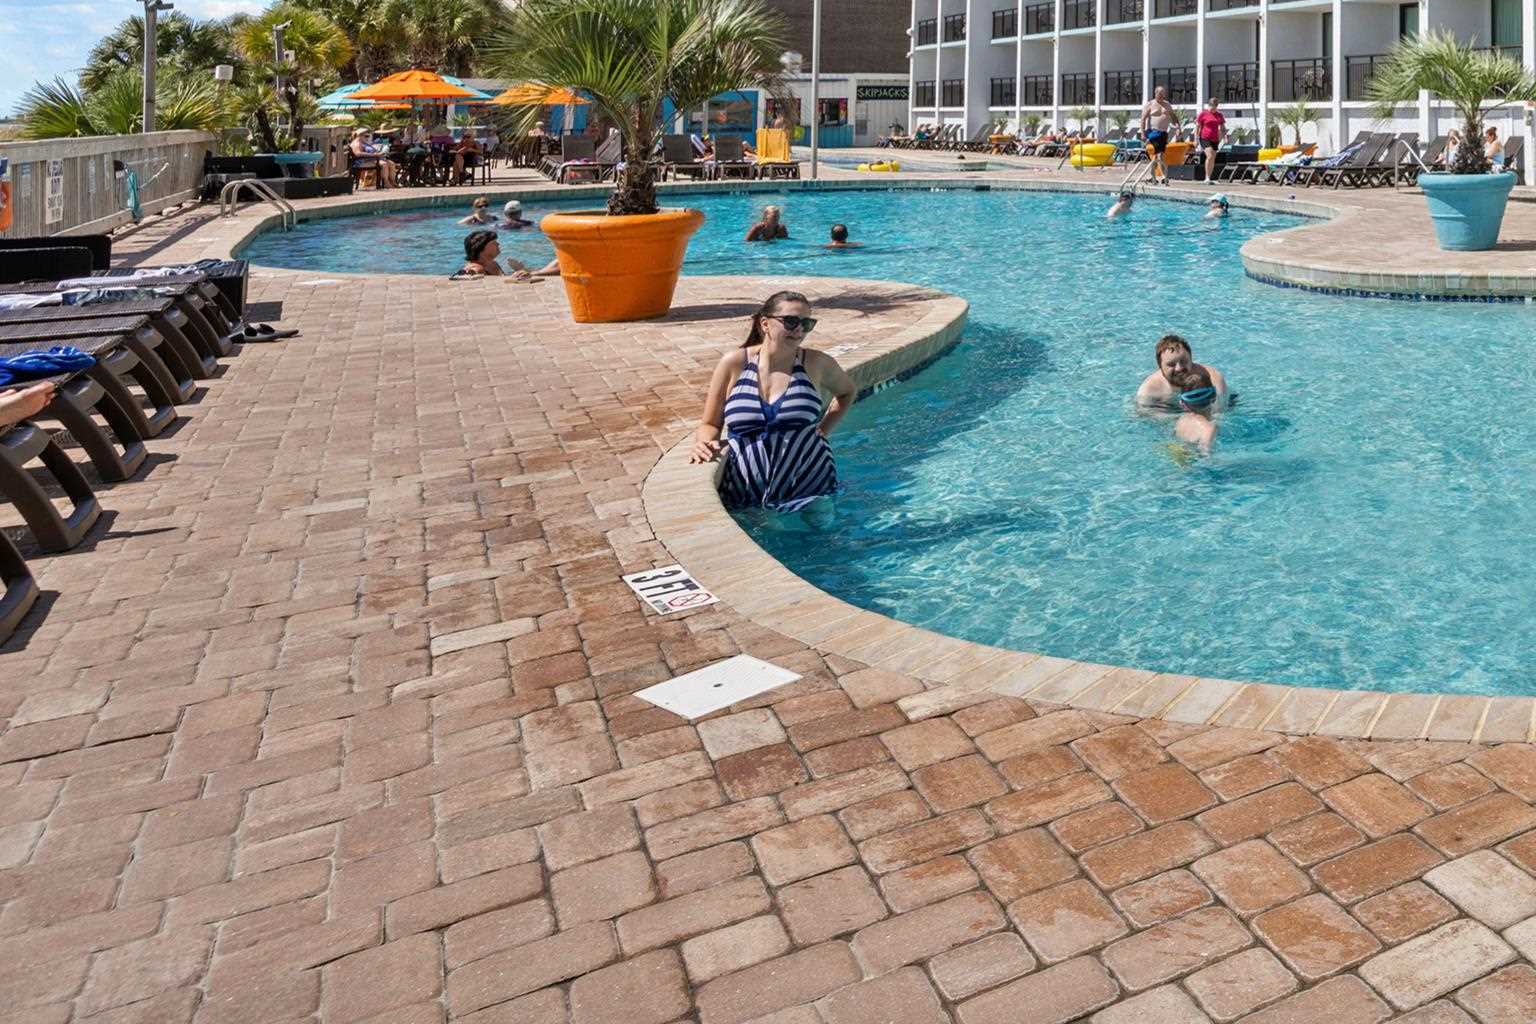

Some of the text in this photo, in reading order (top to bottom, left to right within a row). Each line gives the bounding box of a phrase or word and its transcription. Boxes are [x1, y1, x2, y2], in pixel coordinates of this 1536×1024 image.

[857, 87, 907, 97] SKIPJACKS
[631, 570, 700, 598] 3 FT
